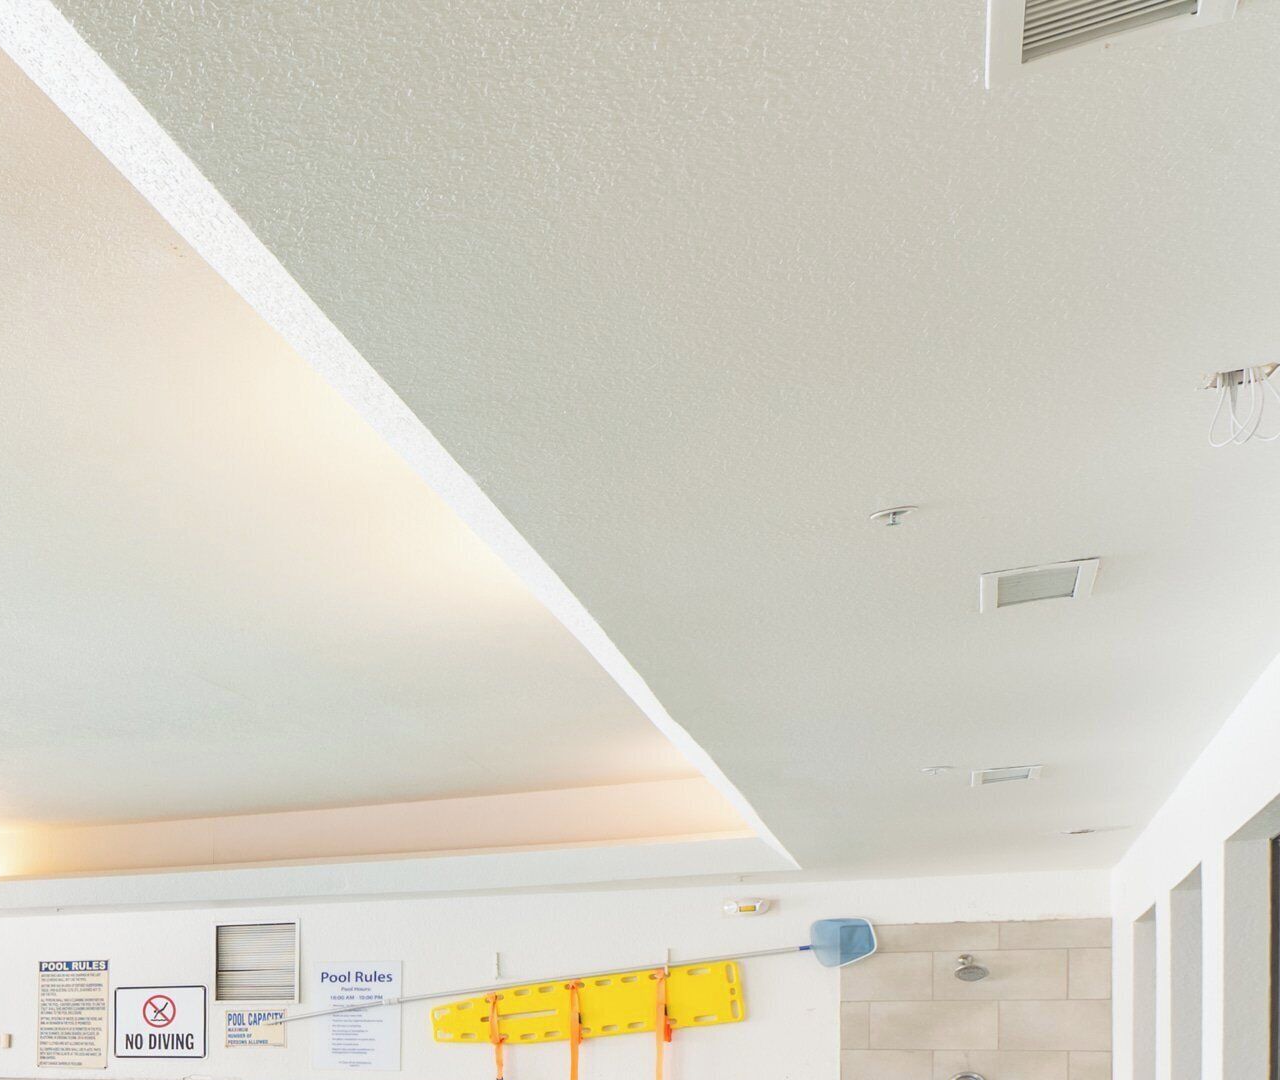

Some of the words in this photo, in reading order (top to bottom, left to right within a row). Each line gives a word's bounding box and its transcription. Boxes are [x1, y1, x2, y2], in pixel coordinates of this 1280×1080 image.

[41, 962, 69, 971] POOL
[71, 961, 106, 970] RULES
[321, 971, 351, 983] Pool
[355, 970, 393, 983] Rules
[227, 1013, 246, 1026] POOL
[125, 1033, 143, 1050] NO
[148, 1033, 195, 1050] DIVING
